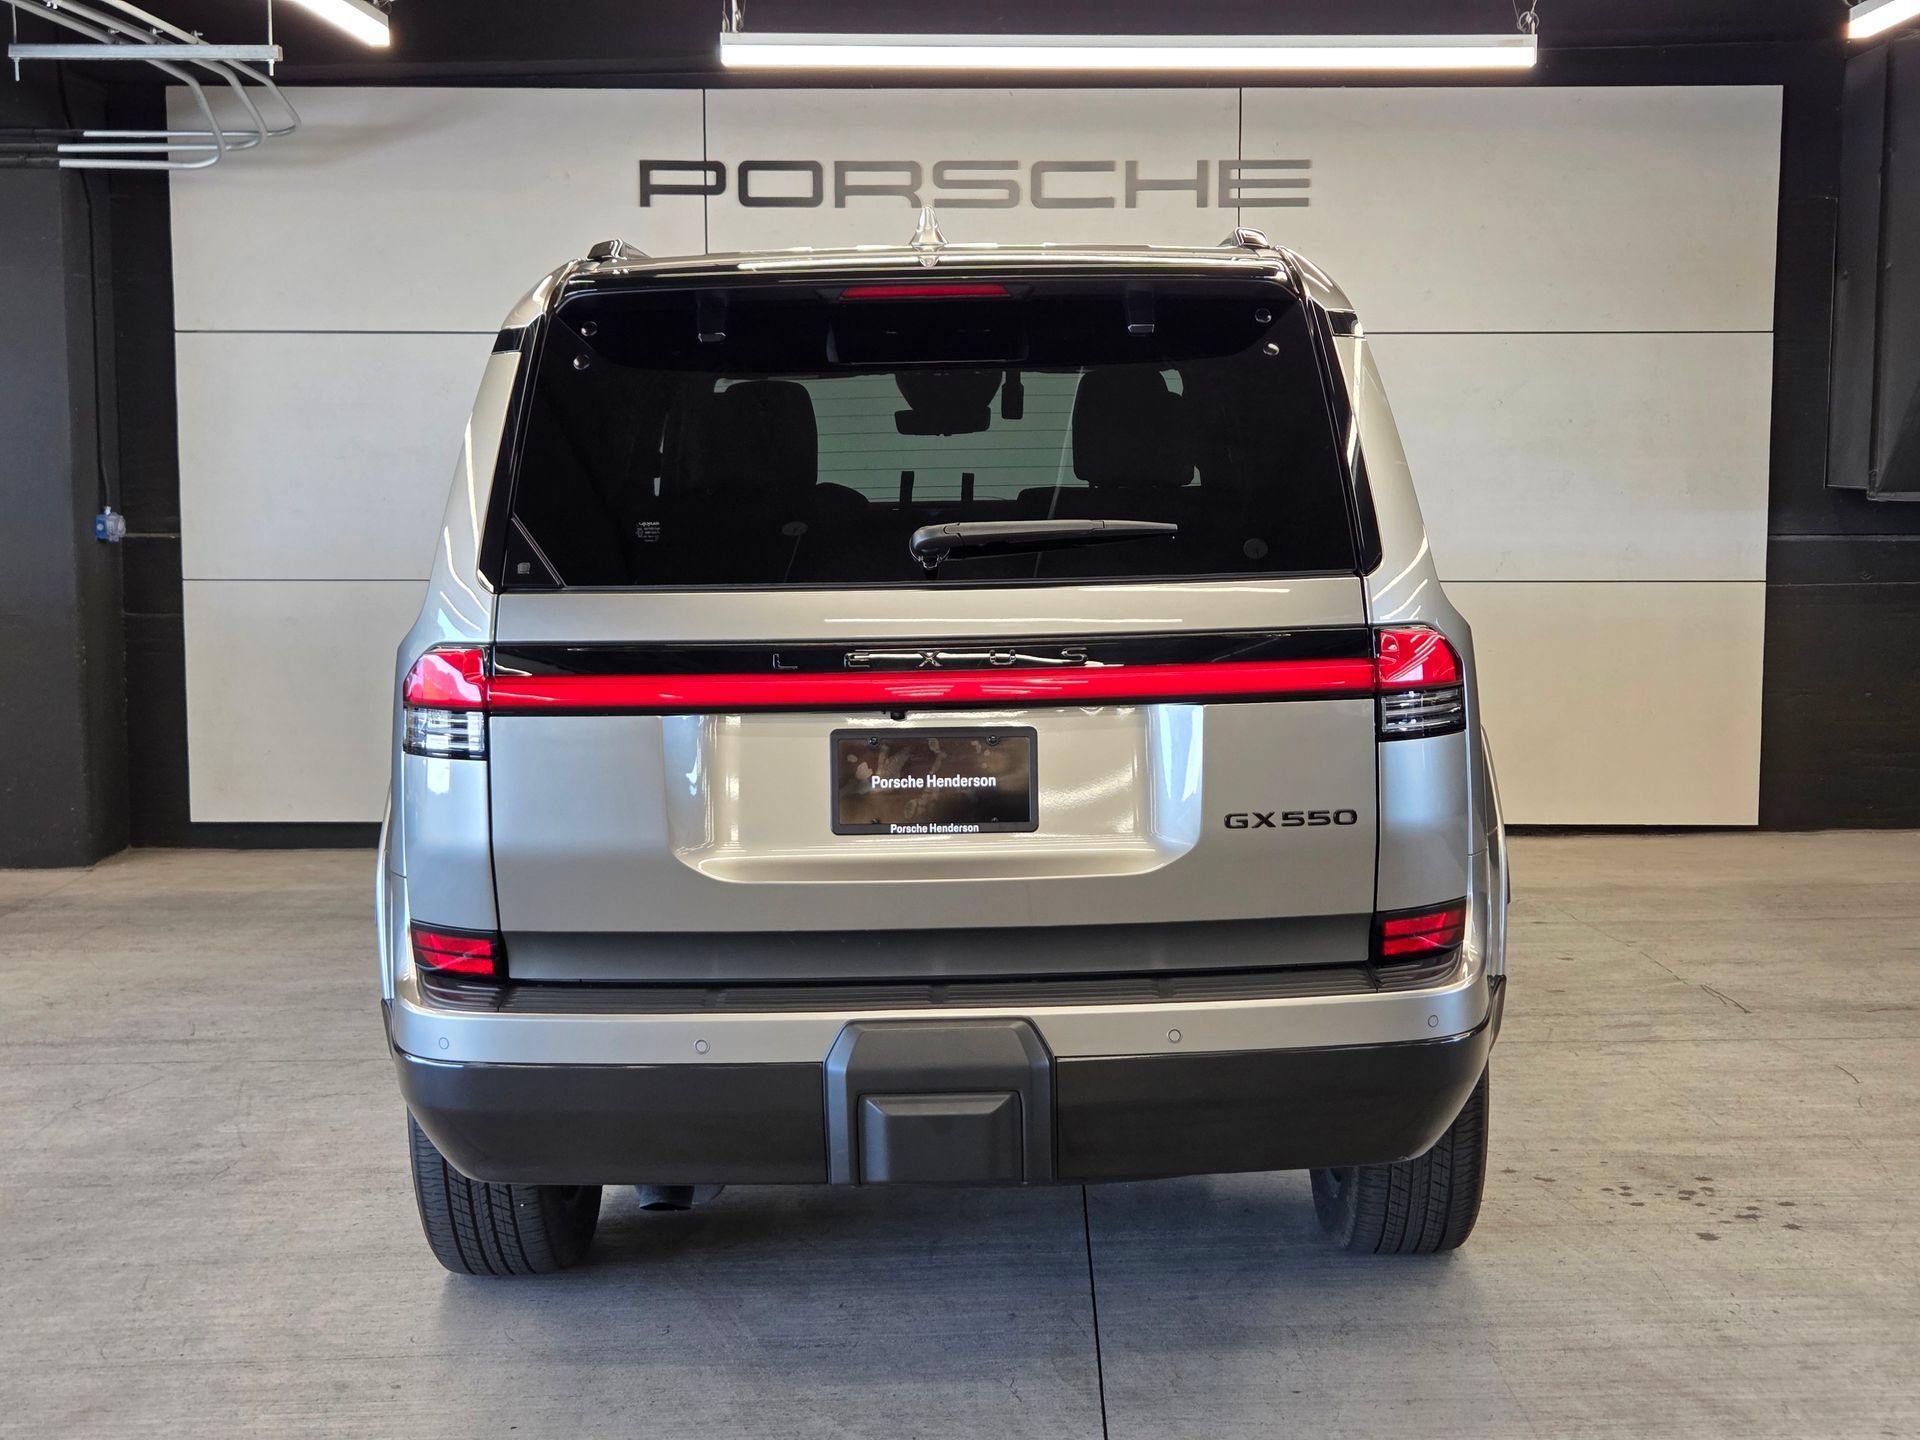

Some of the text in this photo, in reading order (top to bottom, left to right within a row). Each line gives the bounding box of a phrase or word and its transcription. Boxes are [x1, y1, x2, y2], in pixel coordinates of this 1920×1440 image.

[639, 159, 1311, 208] PORSCHE
[771, 647, 1089, 670] LEXUS
[871, 774, 997, 789] Porsche Henderson
[890, 823, 980, 834] Porsche Henderson
